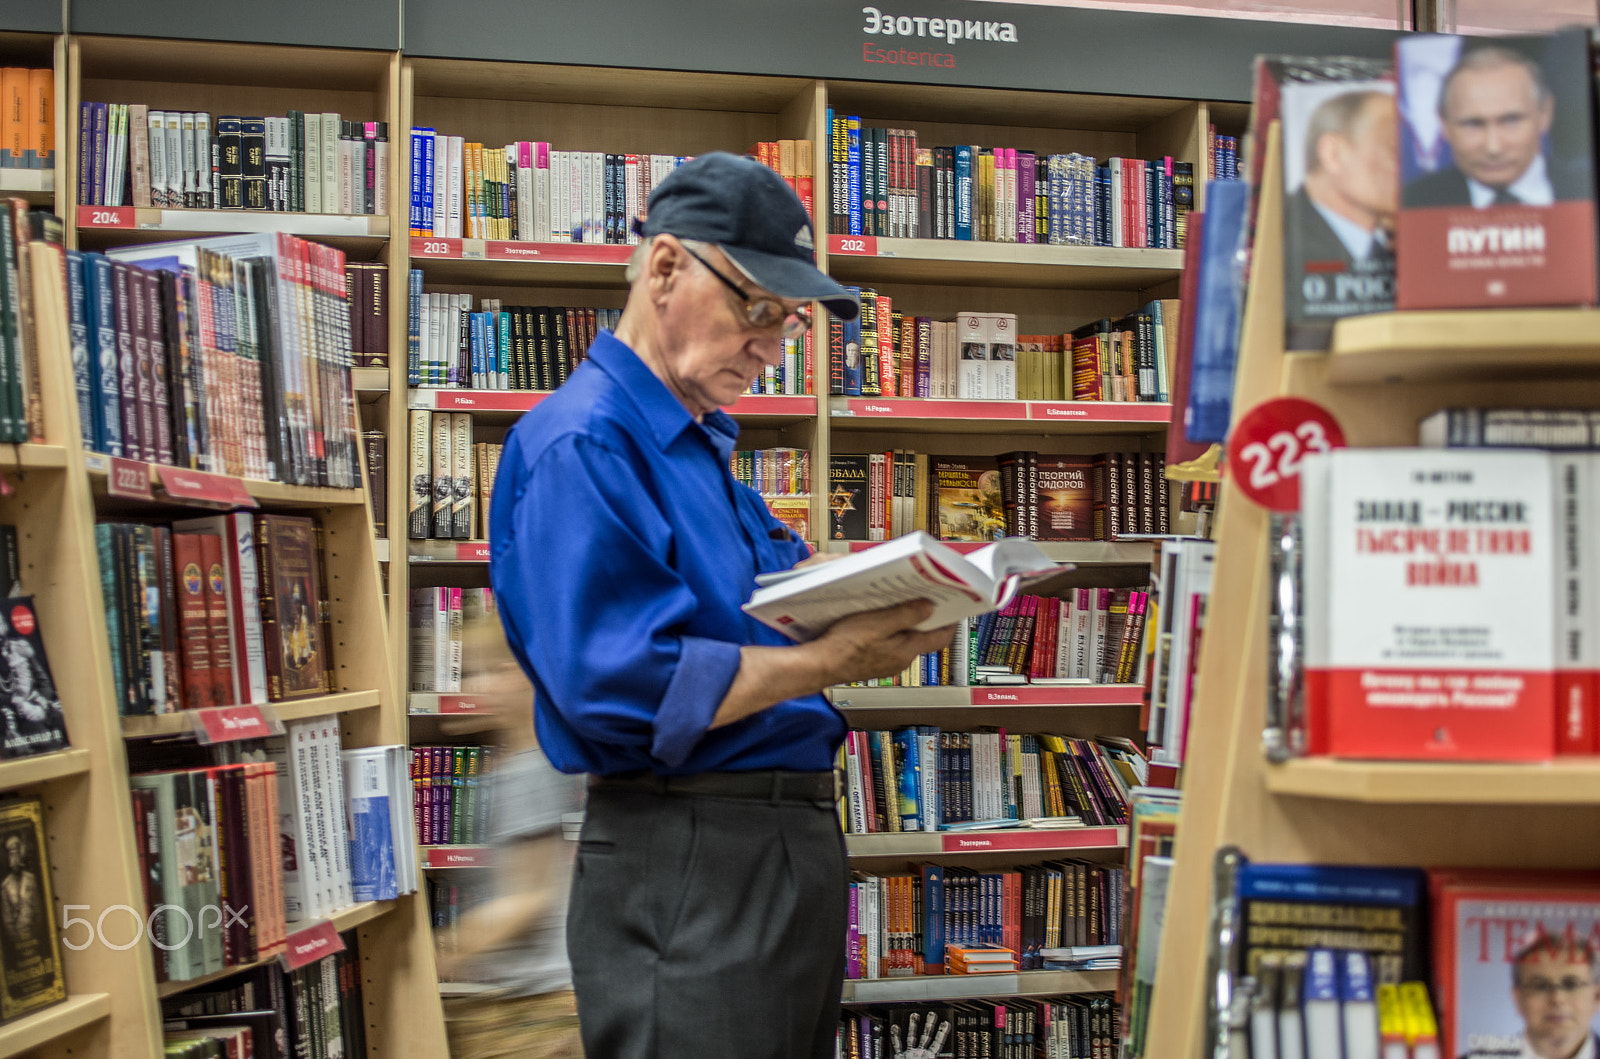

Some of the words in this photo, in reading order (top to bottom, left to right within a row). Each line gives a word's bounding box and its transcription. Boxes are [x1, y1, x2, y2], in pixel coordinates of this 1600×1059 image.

[862, 6, 1018, 45] Эзотерика
[863, 42, 955, 69] Esoterica
[833, 118, 841, 161] МЕДИЦИНА
[841, 118, 849, 161] МЕДИЦИНА
[865, 141, 873, 194] МИСТИЦИЗМ
[878, 141, 886, 195] МИСТИЦИЗМ
[833, 163, 841, 214] КОЛДОВСКАЯ
[841, 163, 849, 214] КОЛДОВСКАЯ
[850, 165, 859, 208] СПИРИТИЗМА
[961, 177, 971, 223] Псевдонаука
[93, 211, 121, 224] 204
[435, 192, 444, 218] Новая
[449, 193, 458, 218] Новая
[1025, 198, 1033, 244] ПРАКТИЧЕСКА
[424, 242, 449, 254] 203
[505, 247, 540, 256] Эзотерика
[841, 239, 866, 251] 202
[1448, 226, 1546, 254] ПУТИН
[877, 300, 888, 339] РЕРИХИ
[831, 323, 843, 379] РЕРИХИ
[880, 345, 888, 361] Йога
[902, 322, 912, 358] РЕРИХИ
[919, 322, 930, 361] РЕРИХИ
[881, 362, 891, 379] Агни
[865, 405, 891, 413] Н.Рерих
[1046, 408, 1087, 416] Е.Блаватская
[416, 415, 425, 468] КАСТАНЕДА
[458, 418, 466, 470] КАСТАНЕДА
[1240, 420, 1330, 490] 223
[829, 468, 866, 478] ББАЛА
[1018, 466, 1026, 504] СИДОРОВ
[1030, 466, 1038, 504] СИДОРОВ
[1038, 480, 1085, 490] СИДОРОВ
[1039, 470, 1083, 480] ГЕОРГИЙ
[1110, 467, 1119, 504] СИДОРОВ
[1127, 468, 1136, 504] СИДОРОВ
[1144, 468, 1153, 504] СИДОРОВ
[1159, 468, 1168, 504] СИДОРОВ
[1355, 500, 1421, 525] ЗАПАД
[1355, 528, 1531, 555] ТЫСЯЧЕЛЕТНЯЯ
[1405, 557, 1480, 587] ВОЙНА
[1076, 634, 1084, 666] ВЗЛОМ
[1096, 634, 1104, 666] ВЗЛОМ
[969, 660, 977, 682] ВАДИМ
[988, 693, 1018, 701] В.Зеланд
[4, 731, 53, 749] АЛЕКСАНДР
[852, 791, 862, 832] ОПРЕДЕЛИСЬ
[959, 839, 991, 847] Эзотерика
[850, 939, 858, 960] СВЕТ
